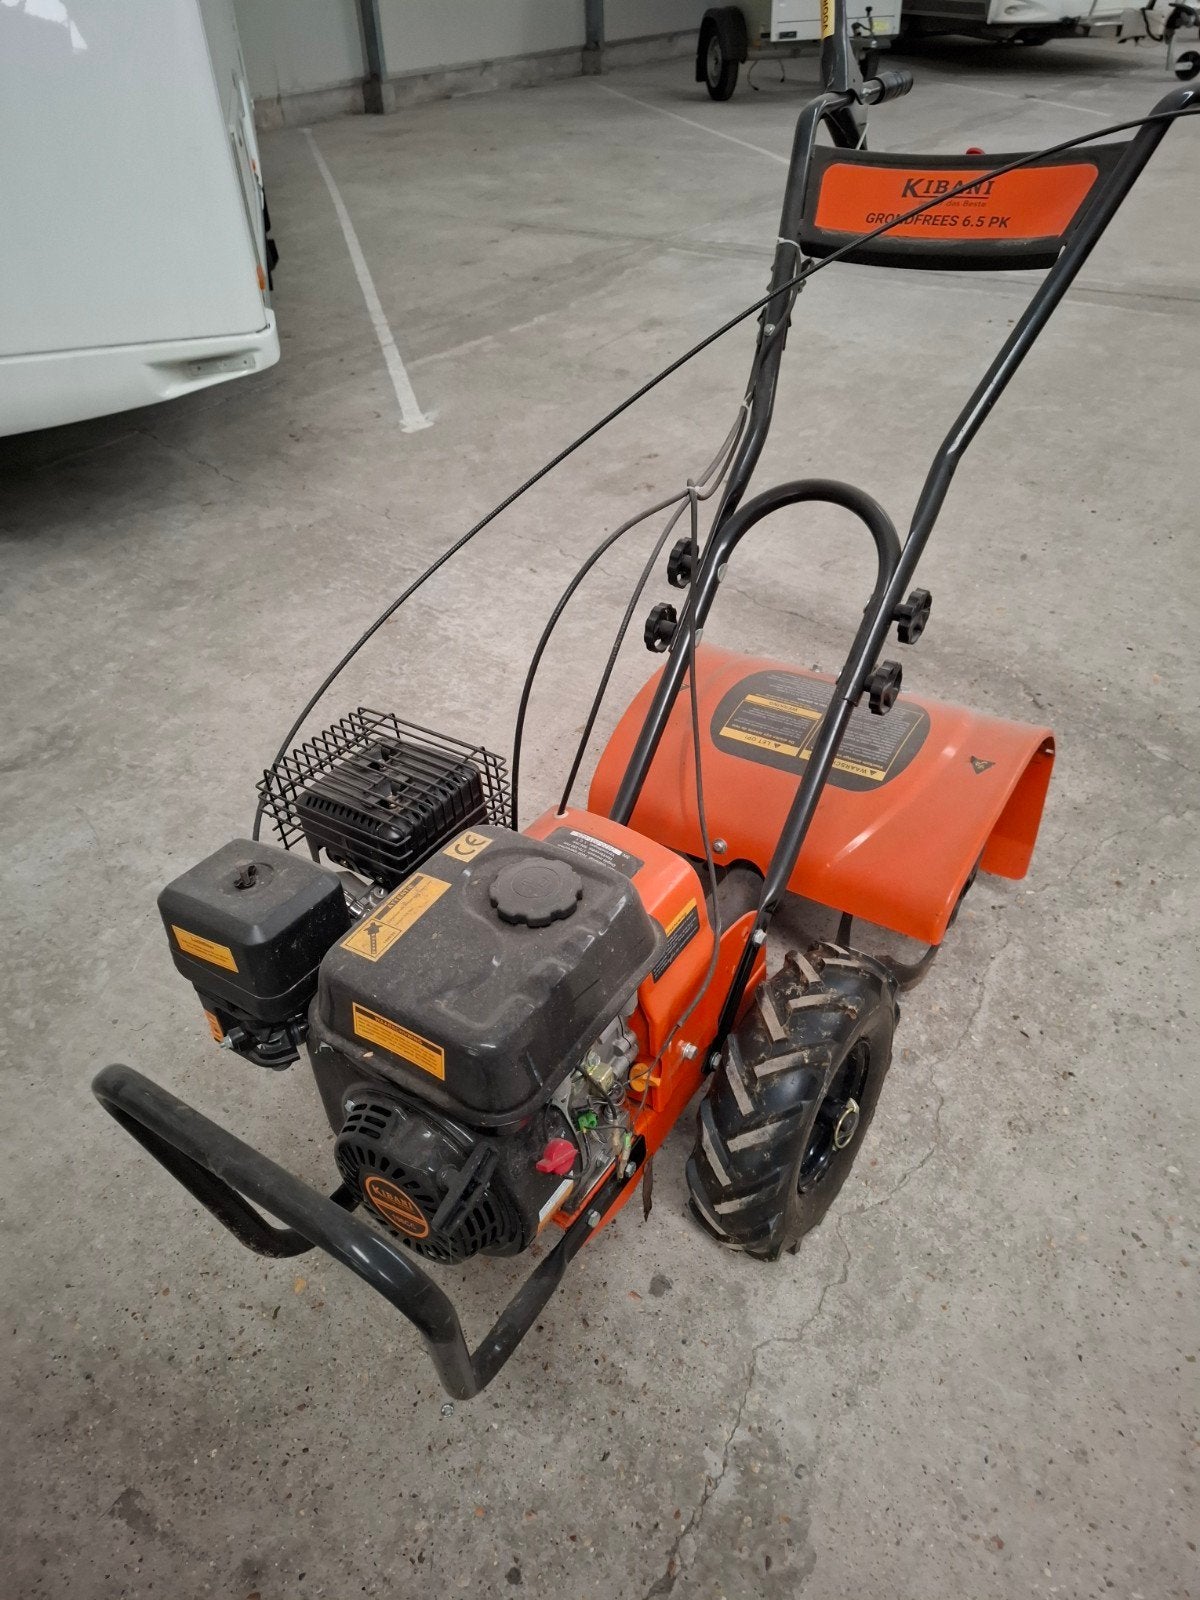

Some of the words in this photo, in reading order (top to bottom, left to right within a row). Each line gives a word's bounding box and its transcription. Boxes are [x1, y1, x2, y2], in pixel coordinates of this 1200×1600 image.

[901, 178, 995, 198] KIBANI
[865, 212, 960, 228] GRODFREES
[962, 215, 986, 228] 6.5
[988, 216, 1011, 228] PK
[758, 738, 772, 746] LET
[833, 760, 868, 774] WAARSC
